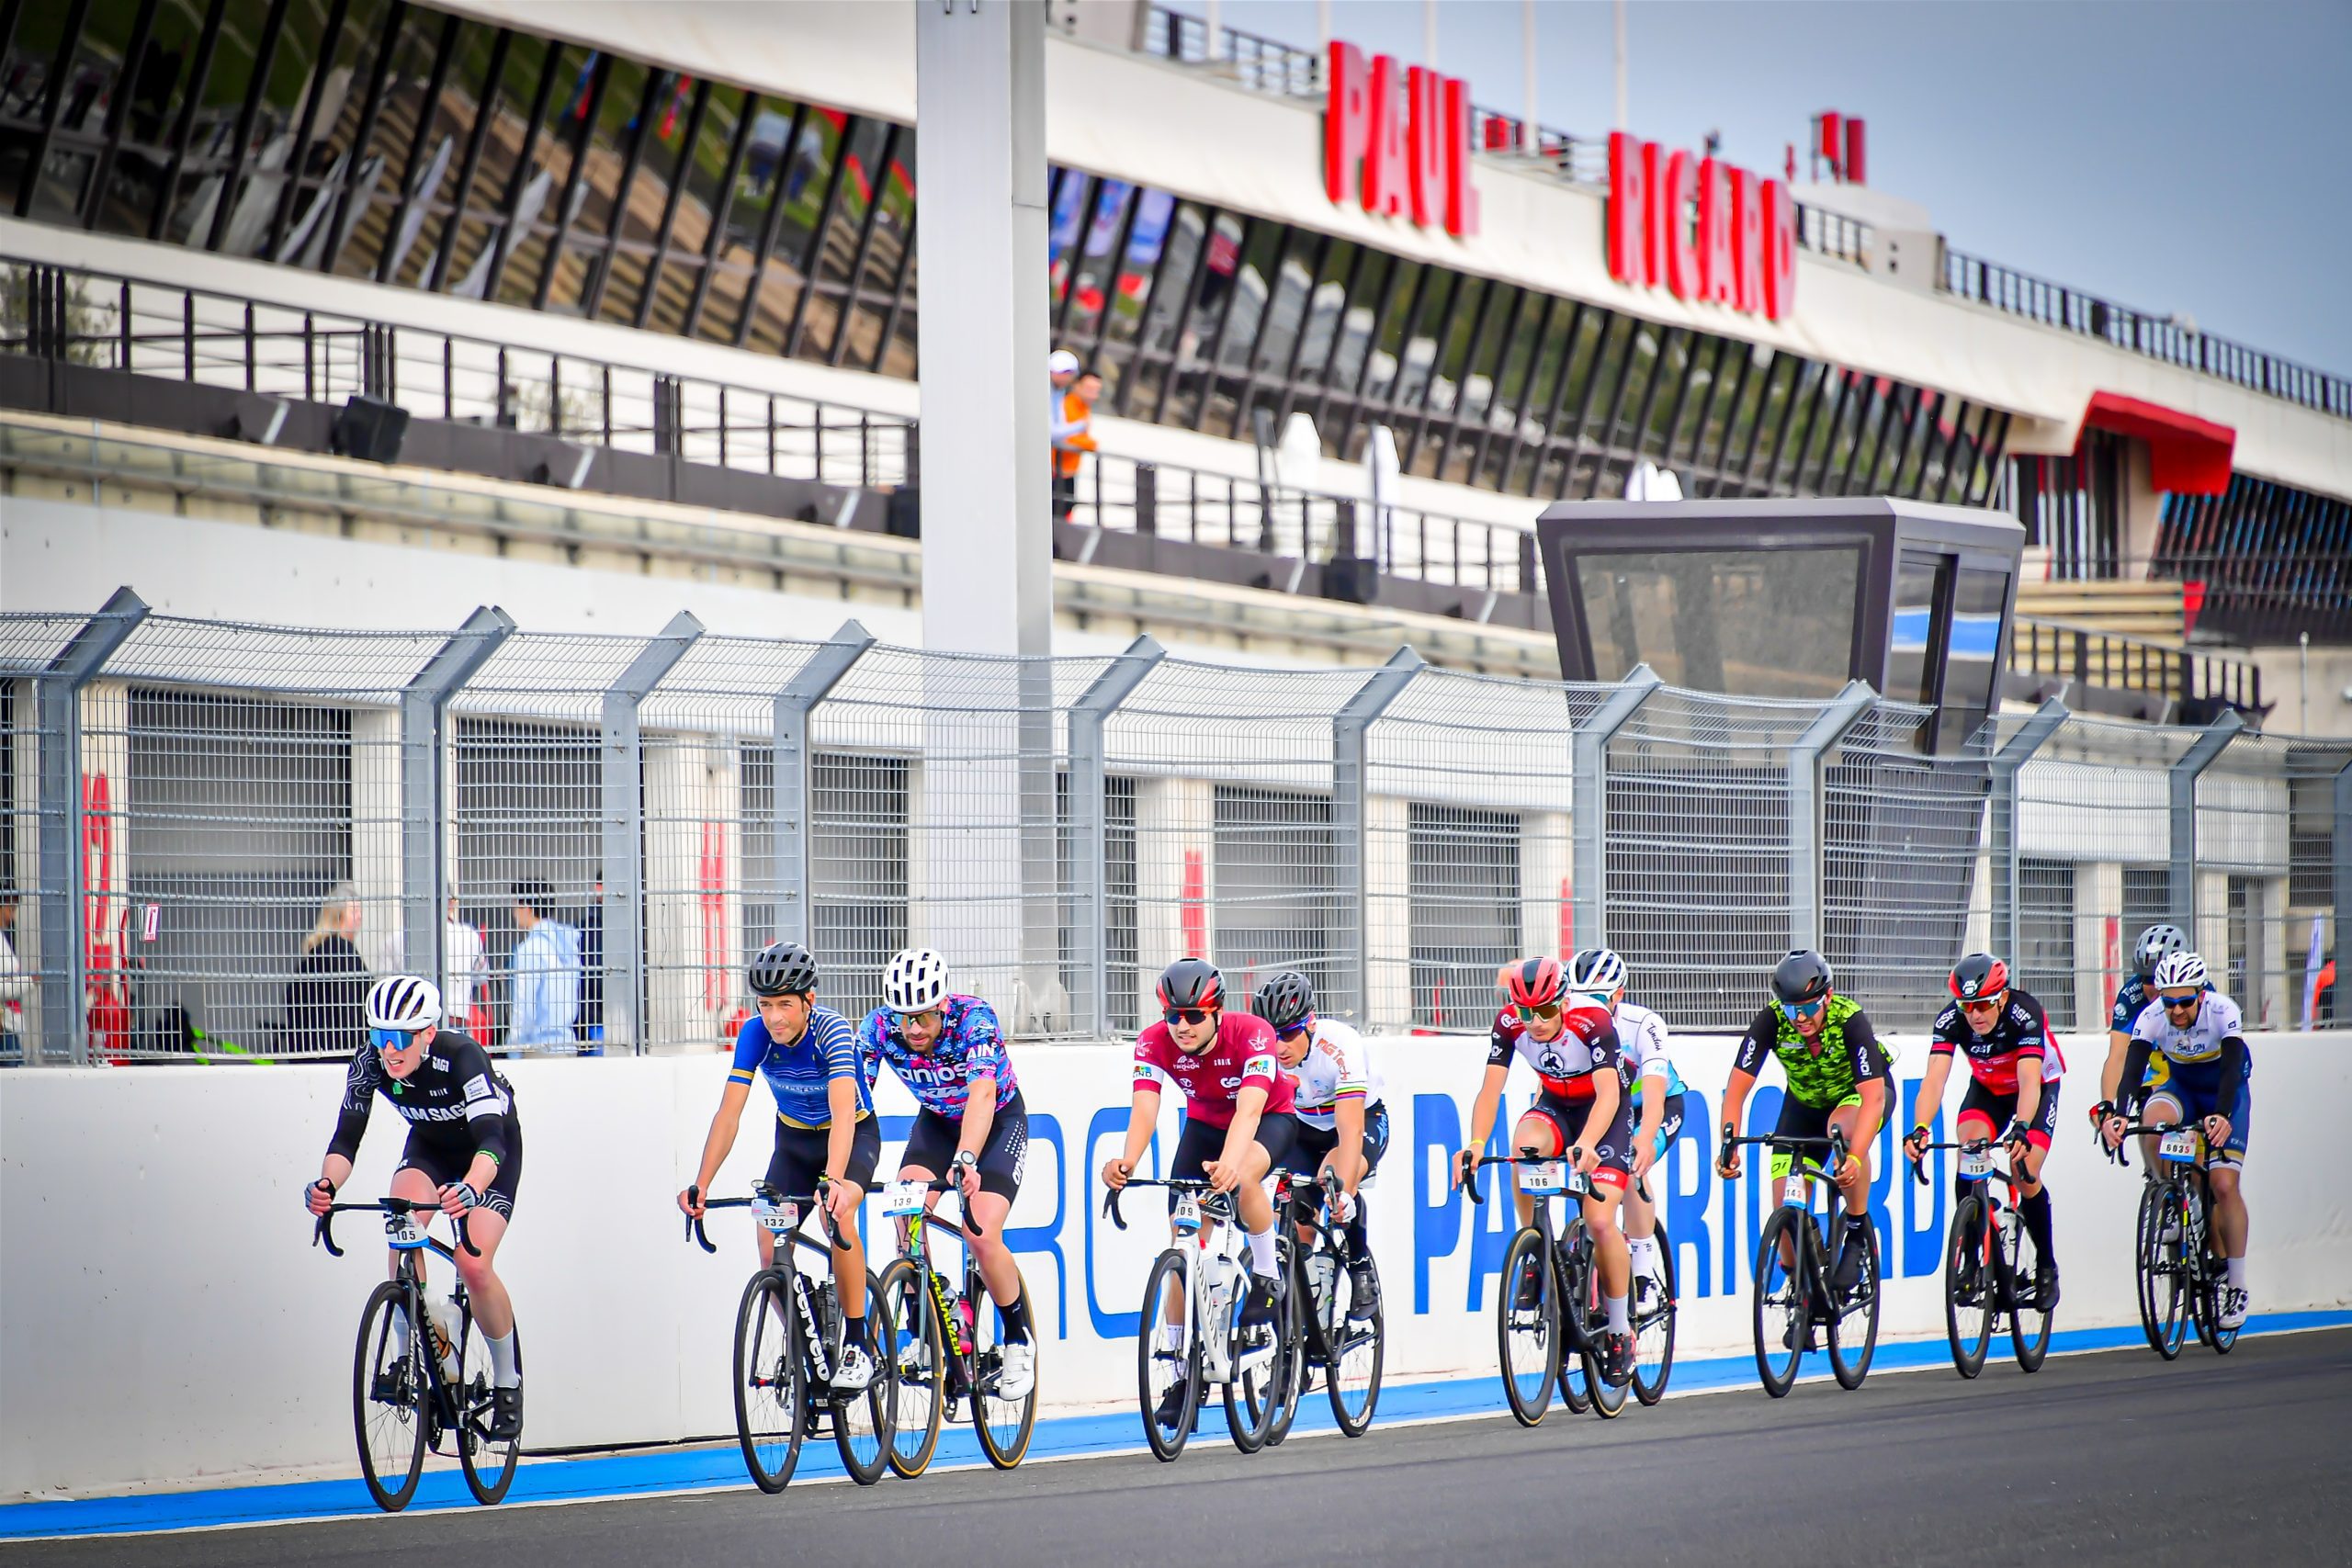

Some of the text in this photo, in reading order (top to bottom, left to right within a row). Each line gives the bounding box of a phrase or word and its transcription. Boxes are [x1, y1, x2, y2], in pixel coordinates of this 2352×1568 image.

[1326, 40, 1798, 321] PAUL RICARD
[1529, 1177, 1548, 1188] 106
[893, 1197, 912, 1208] 139
[763, 1218, 785, 1227] 132
[396, 1230, 416, 1241] 105
